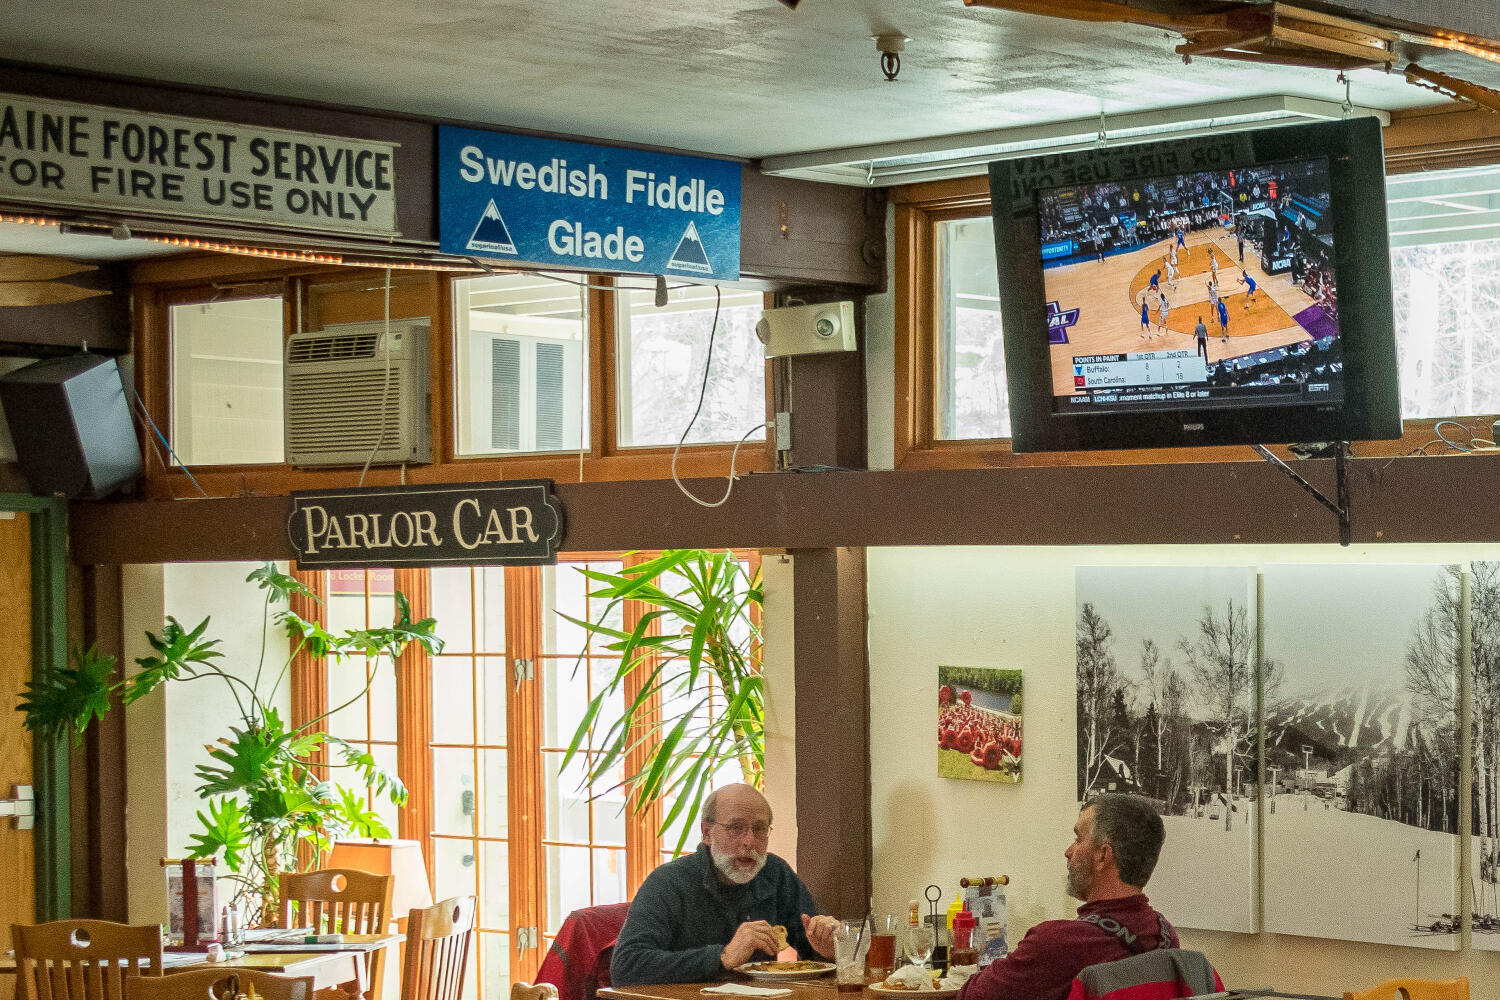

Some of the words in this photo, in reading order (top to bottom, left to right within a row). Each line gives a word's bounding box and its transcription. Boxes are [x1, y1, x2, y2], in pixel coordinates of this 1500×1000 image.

[0, 104, 90, 158] AINE
[102, 119, 237, 173] FOREST
[249, 137, 392, 191] SERVICE
[90, 165, 186, 202] FIRE
[202, 177, 274, 212] USE
[285, 187, 378, 222] ONLY
[459, 145, 608, 200] Swedish
[625, 169, 725, 216] Fiddle
[547, 219, 645, 263] Glade
[1308, 383, 1329, 392] ESPN
